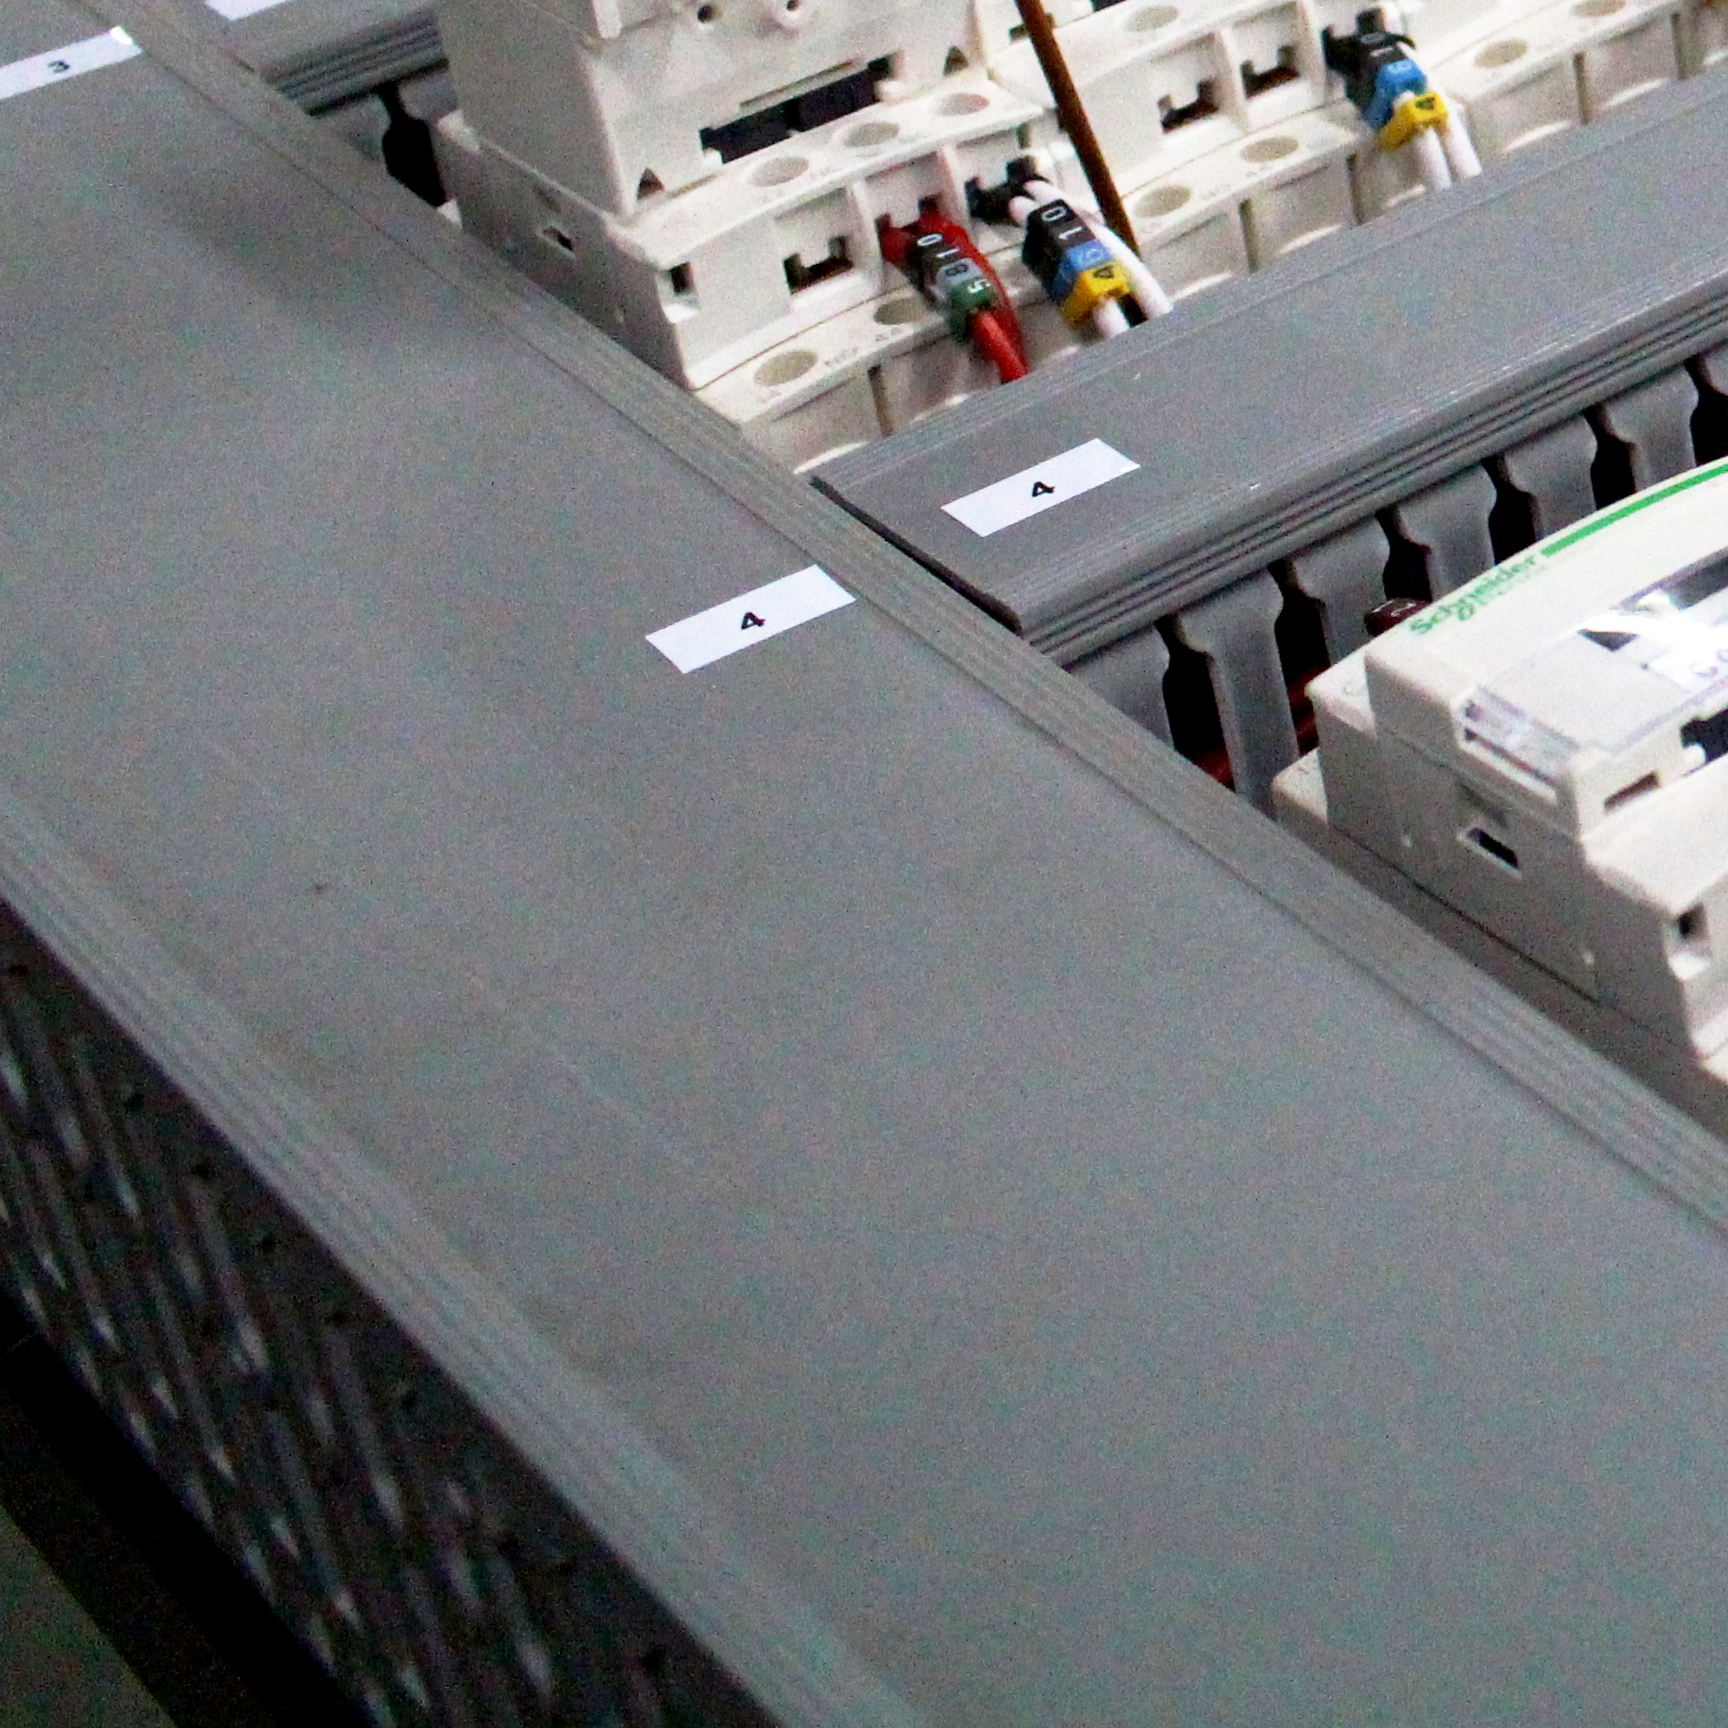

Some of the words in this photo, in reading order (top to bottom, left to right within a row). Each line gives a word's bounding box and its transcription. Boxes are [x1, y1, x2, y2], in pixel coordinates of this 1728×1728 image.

[1030, 480, 1056, 499] 4
[1409, 554, 1537, 635] Schneider
[740, 611, 766, 631] 4
